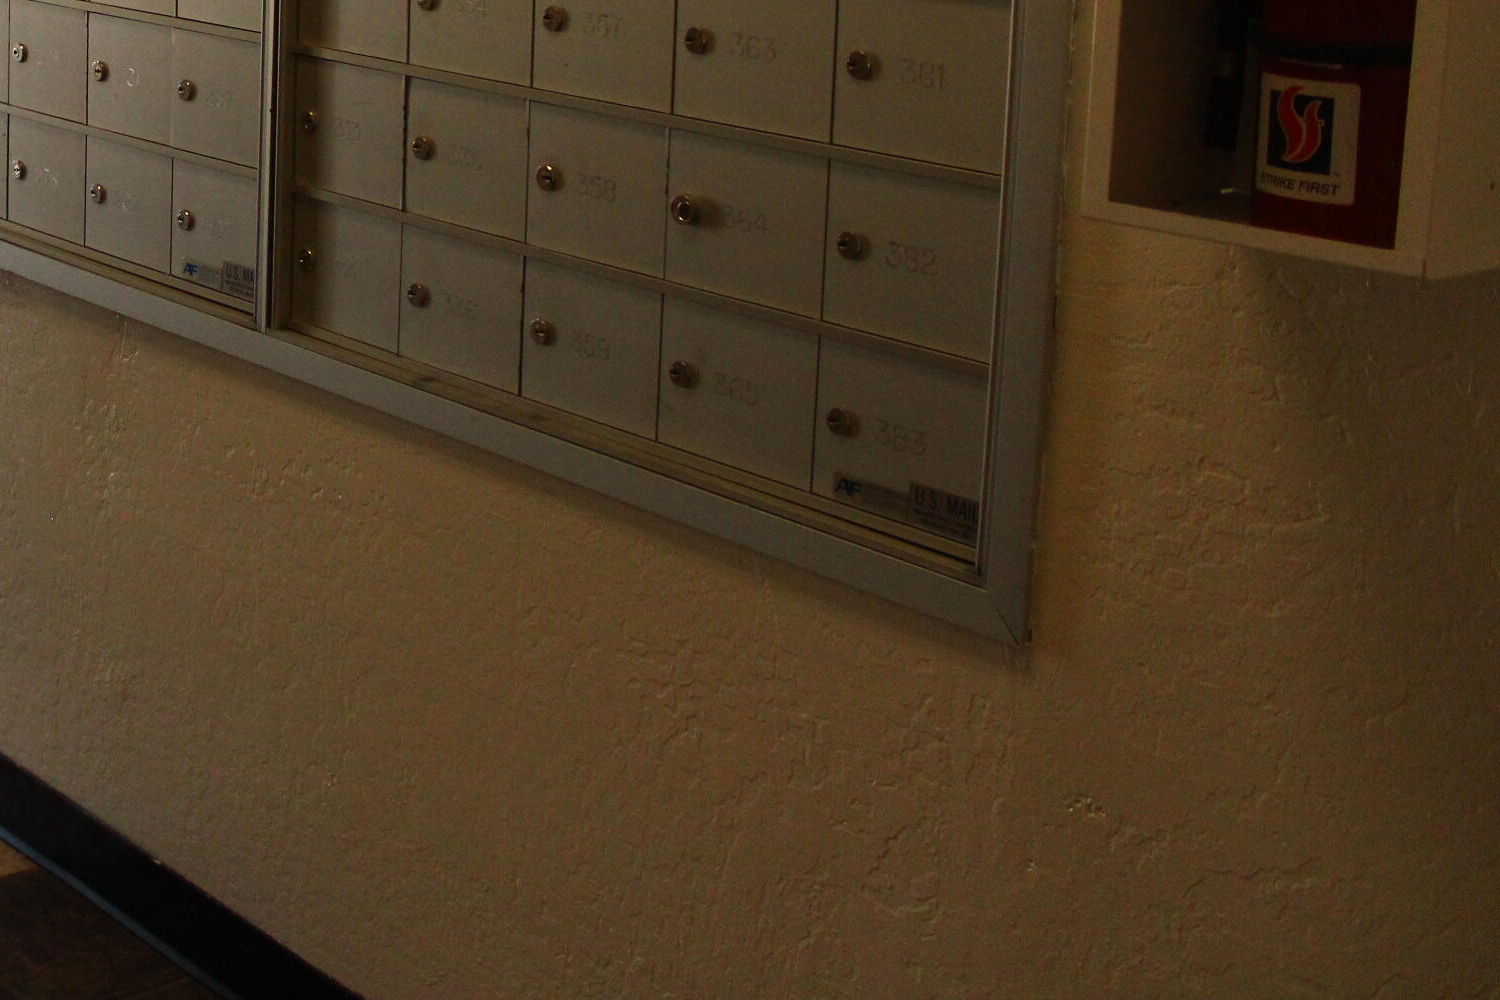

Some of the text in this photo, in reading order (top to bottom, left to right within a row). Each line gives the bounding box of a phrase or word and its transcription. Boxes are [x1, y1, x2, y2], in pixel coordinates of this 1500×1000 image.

[730, 33, 777, 62] 363
[1261, 172, 1341, 196] STRIKE FIRST
[886, 241, 938, 276] 382
[714, 373, 758, 406] 365
[876, 419, 926, 456] 383
